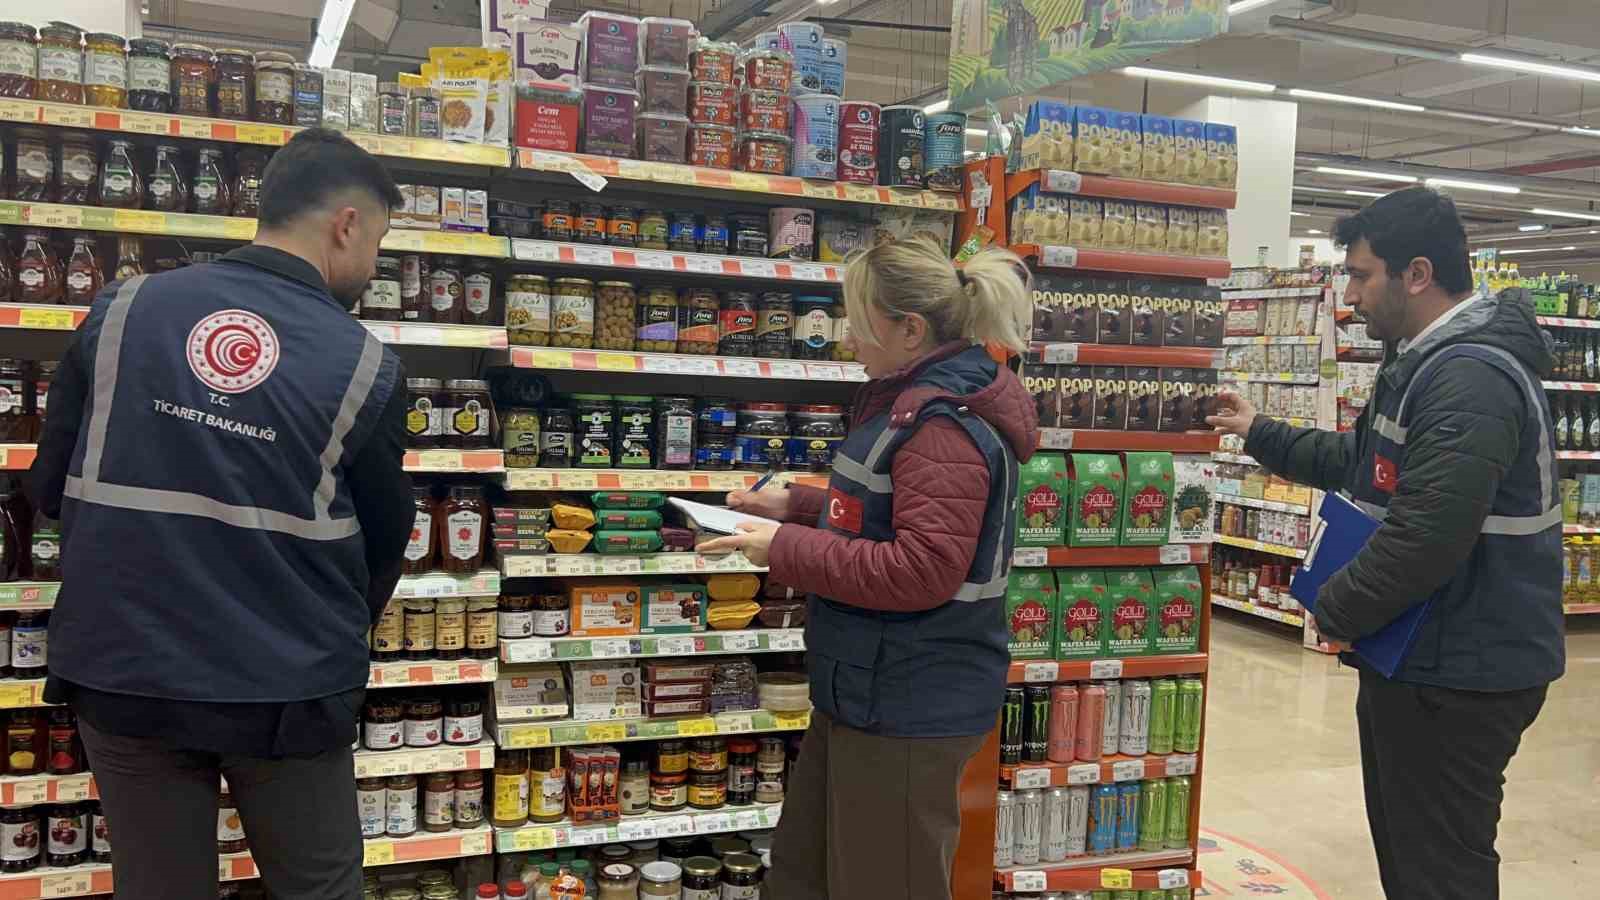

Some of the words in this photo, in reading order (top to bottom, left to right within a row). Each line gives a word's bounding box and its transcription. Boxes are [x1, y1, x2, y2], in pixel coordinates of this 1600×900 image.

[538, 106, 560, 117] Cem
[208, 392, 231, 408] T.C.
[153, 399, 205, 422] TİCARET
[206, 414, 276, 442] BAKANLIĞI
[1028, 493, 1057, 505] GOLD
[1084, 493, 1113, 505] GOLD
[1135, 493, 1164, 506] GOLD
[1016, 607, 1046, 624] GOLD
[1069, 608, 1097, 624] GOLD
[1116, 606, 1145, 620] GOLD
[1163, 604, 1193, 619] GOLD
